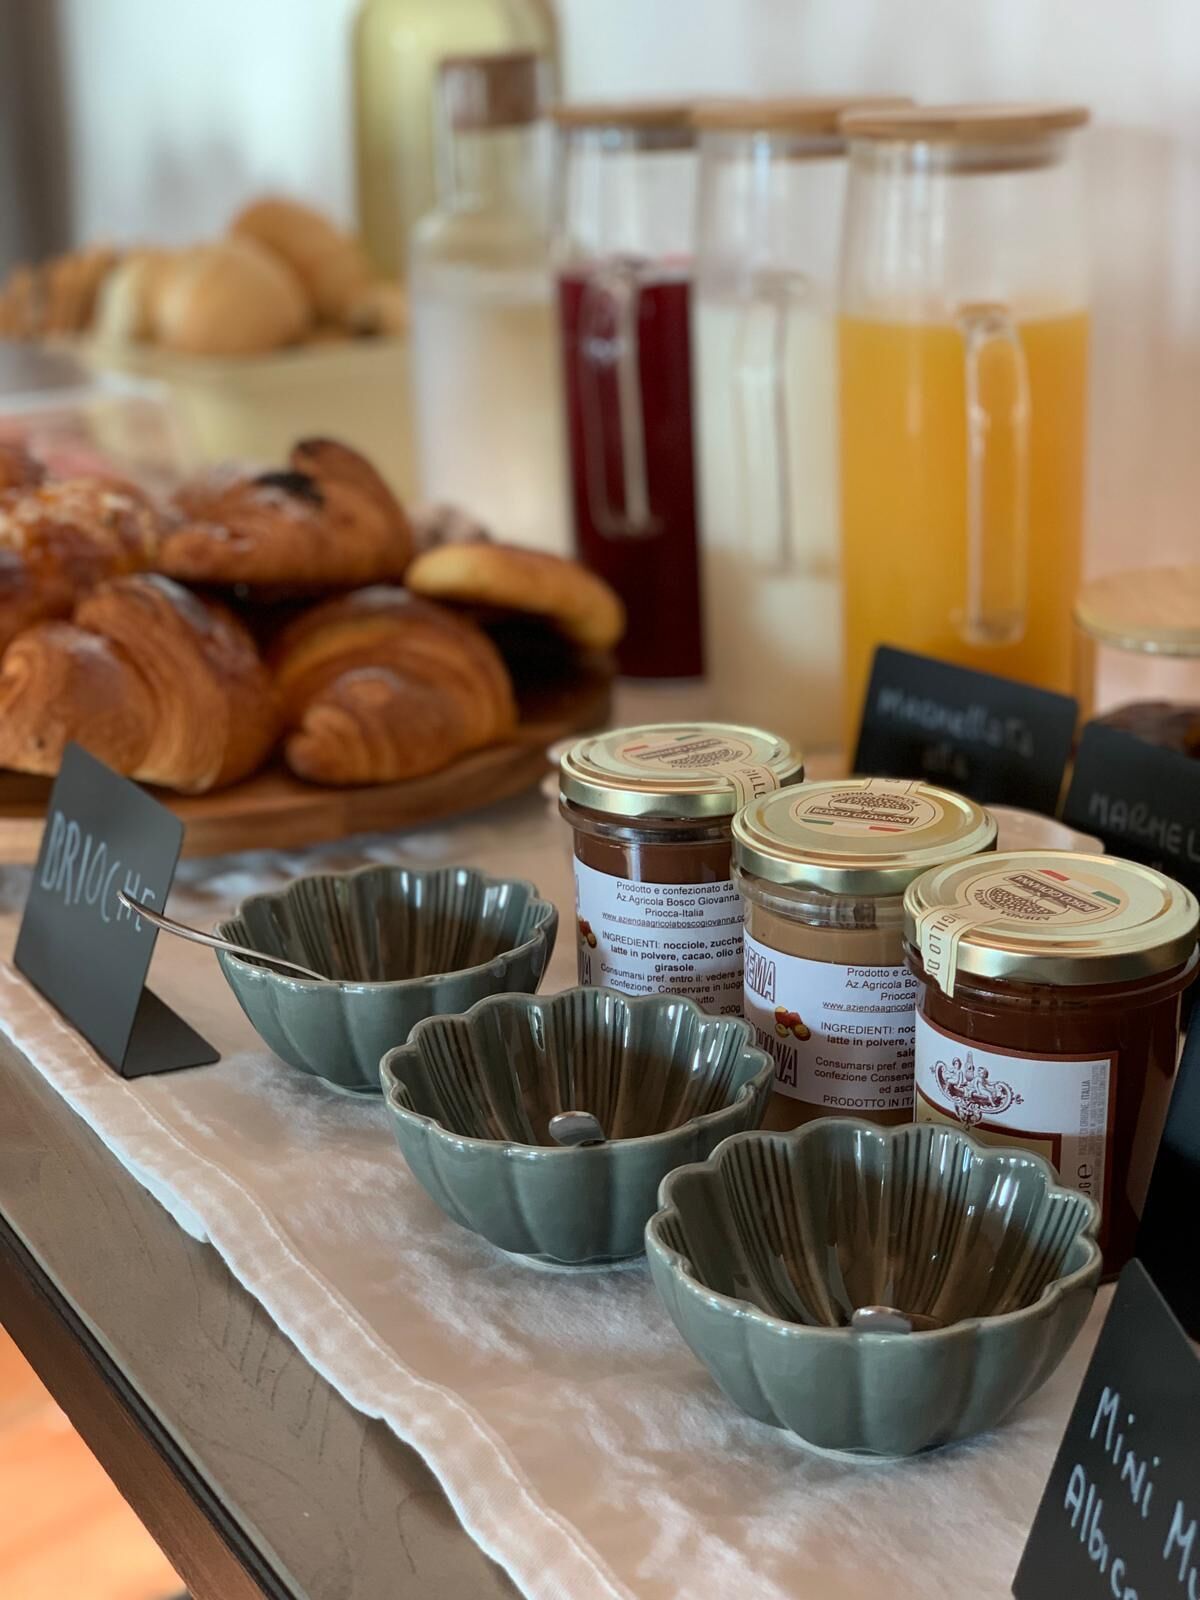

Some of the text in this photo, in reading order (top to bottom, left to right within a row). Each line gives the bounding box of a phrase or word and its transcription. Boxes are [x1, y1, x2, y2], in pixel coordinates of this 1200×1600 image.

[812, 807, 911, 824] BOSCO GIOVANNA
[1087, 791, 1200, 863] MARMEL
[616, 881, 734, 895] Prodotto e confezionato da
[666, 898, 695, 906] Bosco
[698, 895, 740, 905] Giovanna
[645, 908, 704, 918] Priocca-Italia
[602, 930, 743, 950] INGREDIENTI: nocciole, zucche
[610, 945, 627, 956] latte
[630, 948, 638, 957] in
[641, 950, 679, 962] polvere,
[716, 949, 733, 958] olio
[600, 962, 645, 980] Consumarsi
[669, 975, 693, 983] entro
[706, 972, 736, 981] vedere
[847, 967, 889, 977] Prodotto
[658, 984, 710, 994] Conservare
[713, 984, 720, 992] in
[904, 978, 918, 988] Bo
[880, 991, 916, 1001] Priocca
[720, 1004, 741, 1015] 200g
[820, 1022, 916, 1034] INGREDIENTI: noc
[827, 1034, 850, 1046] latte
[852, 1037, 863, 1046] in
[866, 1038, 908, 1048] polvere,
[815, 1056, 874, 1071] Consumarsi
[870, 1072, 915, 1083] Conserva
[878, 1085, 891, 1094] ed
[823, 1094, 886, 1108] PRODOTTO
[888, 1098, 899, 1107] IN
[1162, 1499, 1200, 1600] M
